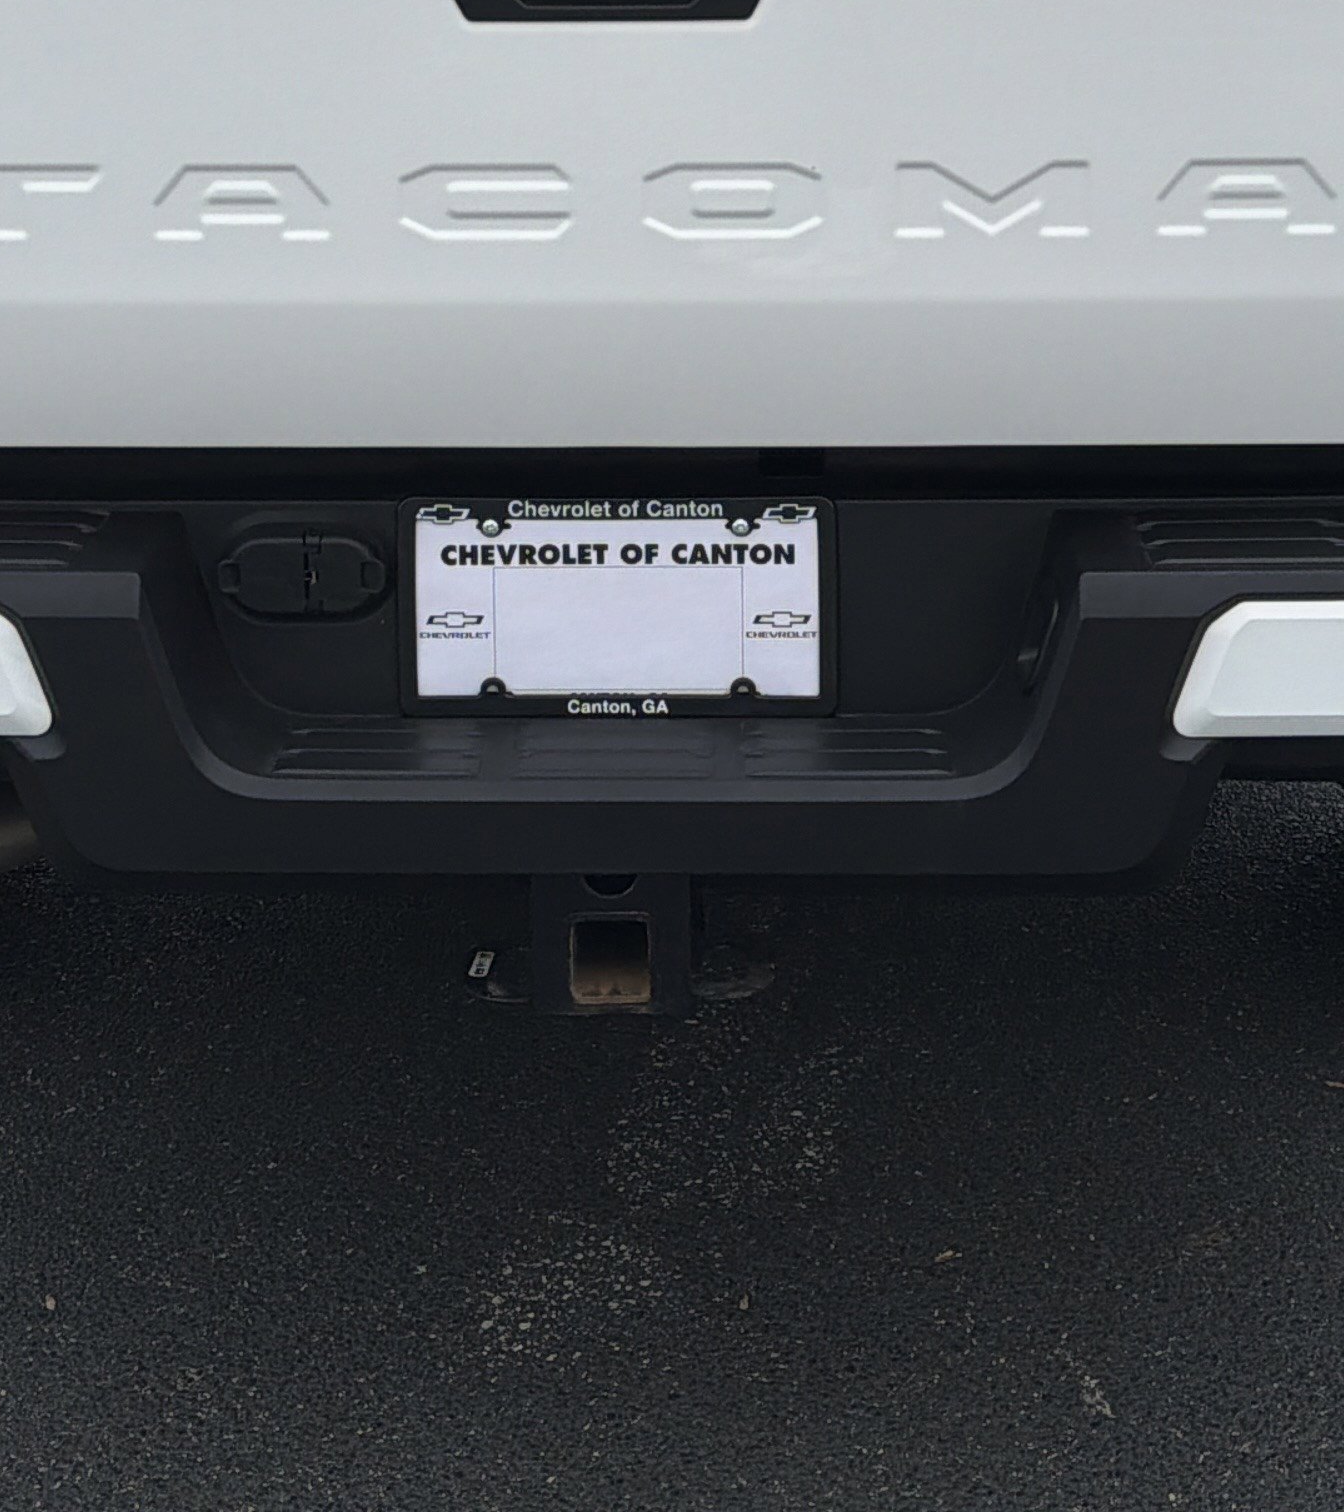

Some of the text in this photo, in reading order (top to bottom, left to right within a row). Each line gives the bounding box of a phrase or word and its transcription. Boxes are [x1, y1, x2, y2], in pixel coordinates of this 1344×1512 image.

[507, 500, 723, 519] Chevrolet of Canton
[440, 543, 796, 566] CHEVROLET OF CANTON
[419, 631, 491, 640] CHEVROLET
[745, 630, 818, 639] CHEVROLET
[567, 699, 669, 716] Canton, GA
